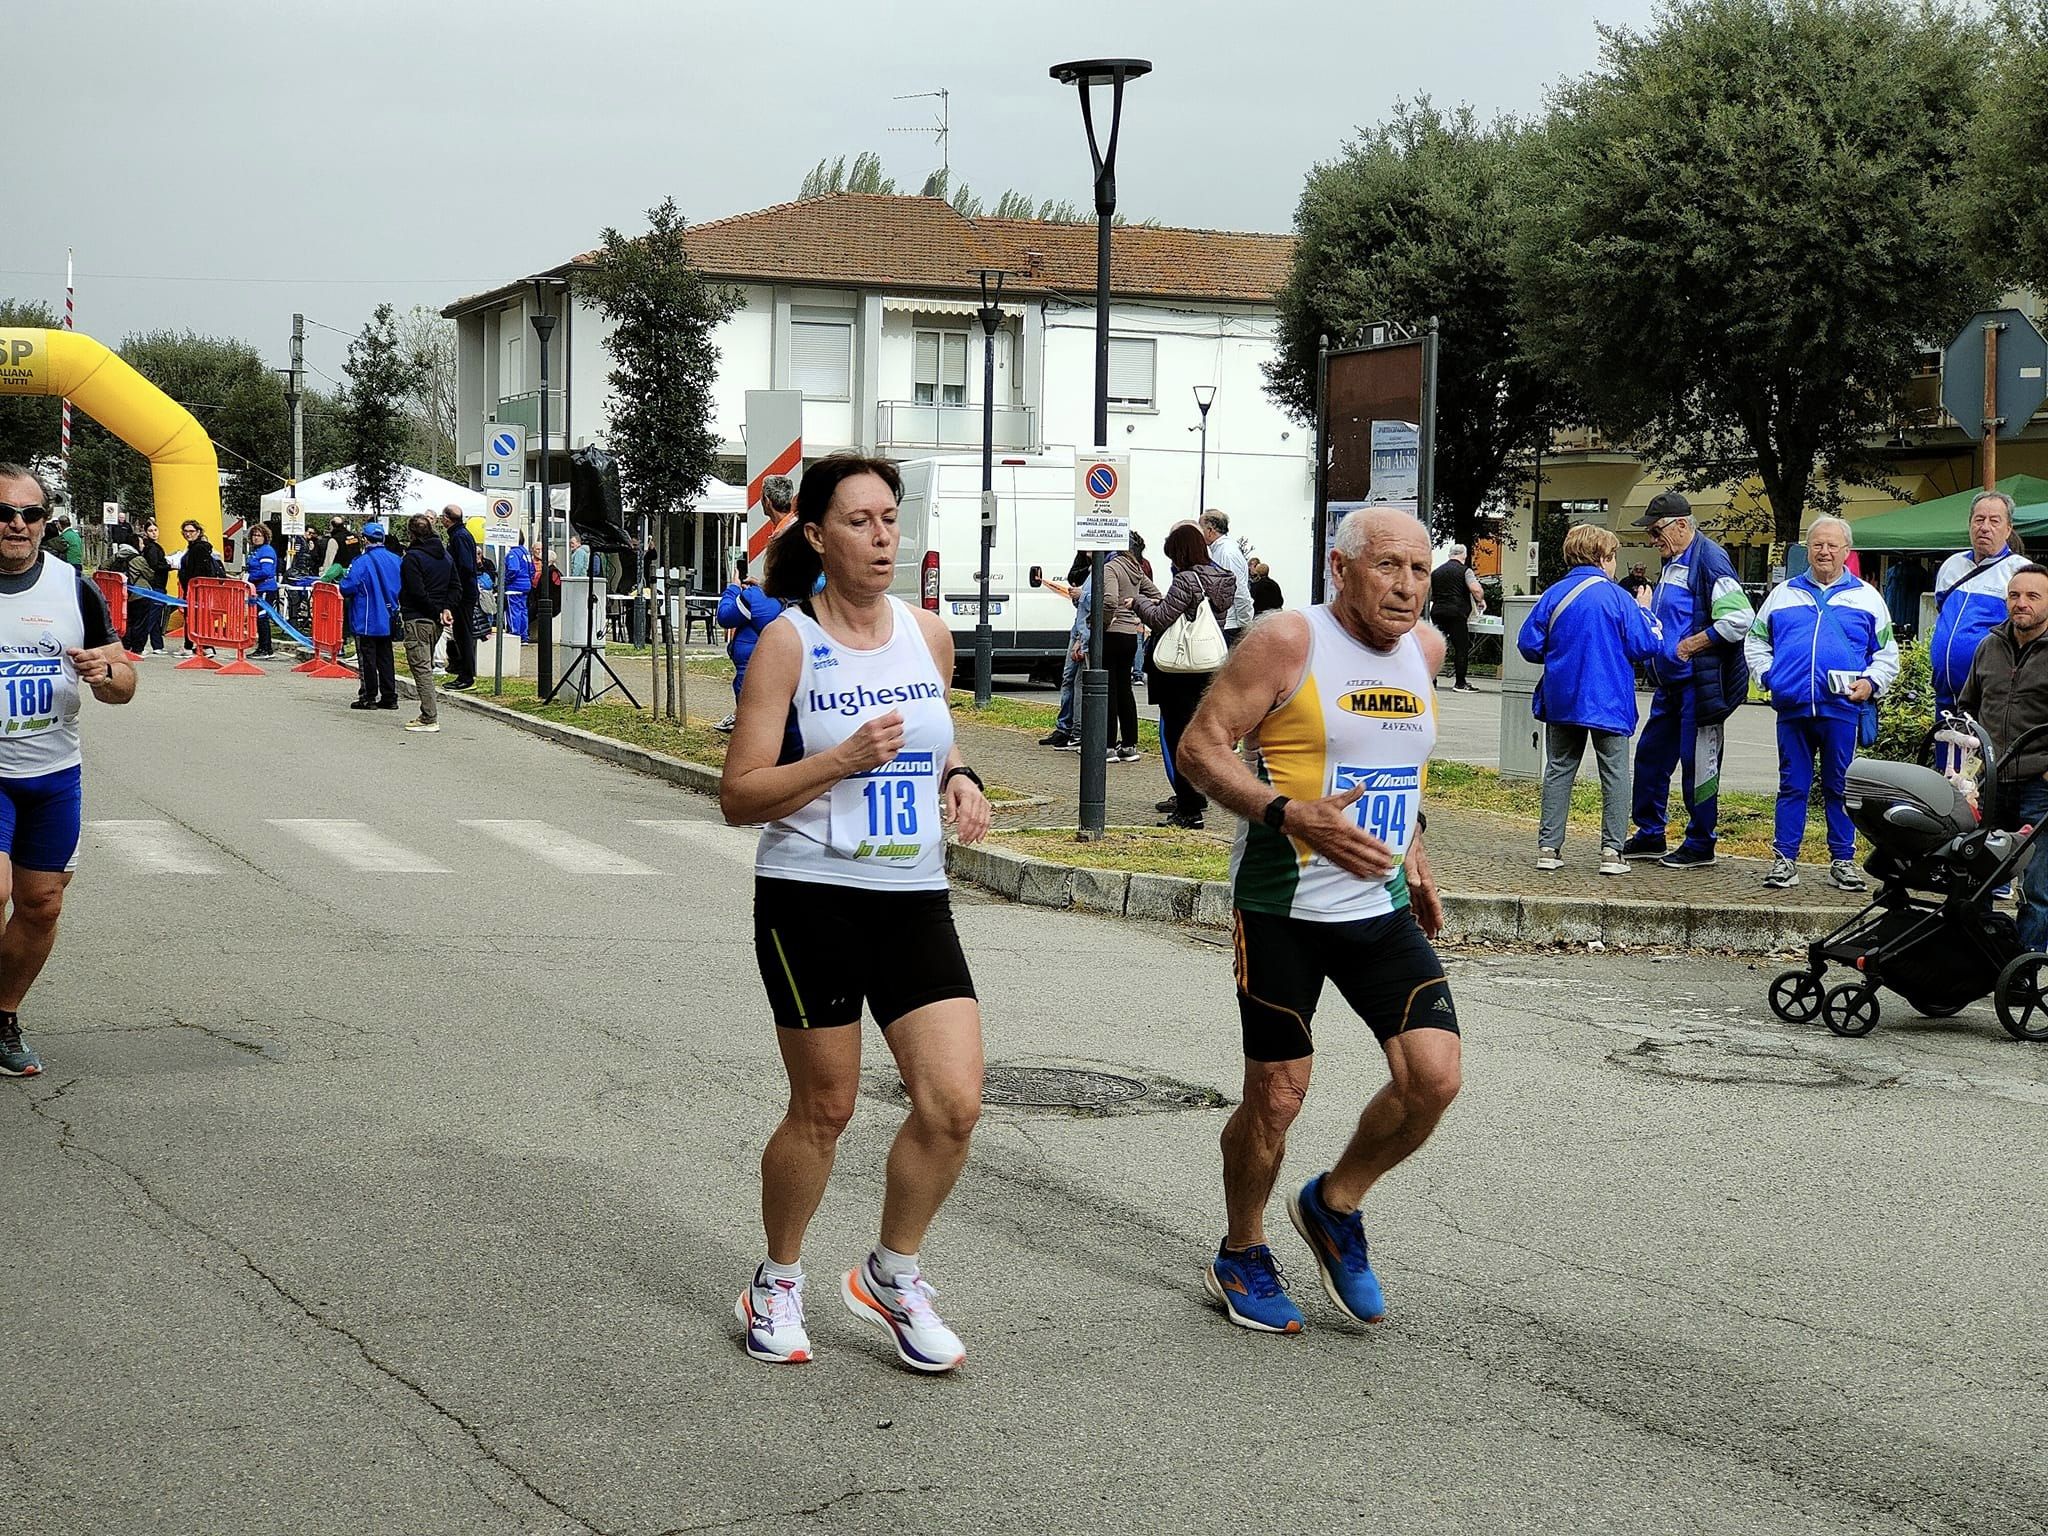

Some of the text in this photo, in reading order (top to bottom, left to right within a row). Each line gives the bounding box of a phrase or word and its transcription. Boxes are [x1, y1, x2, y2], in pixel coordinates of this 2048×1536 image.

[3, 377, 28, 386] TUTTI
[1374, 449, 1417, 470] Ivan Alvisi
[5, 678, 53, 717] 180
[809, 681, 941, 716] lughesina
[1350, 694, 1419, 714] MAMELI
[1380, 721, 1424, 733] RAVENNA
[863, 779, 918, 836] 113
[1355, 793, 1406, 846] 194
